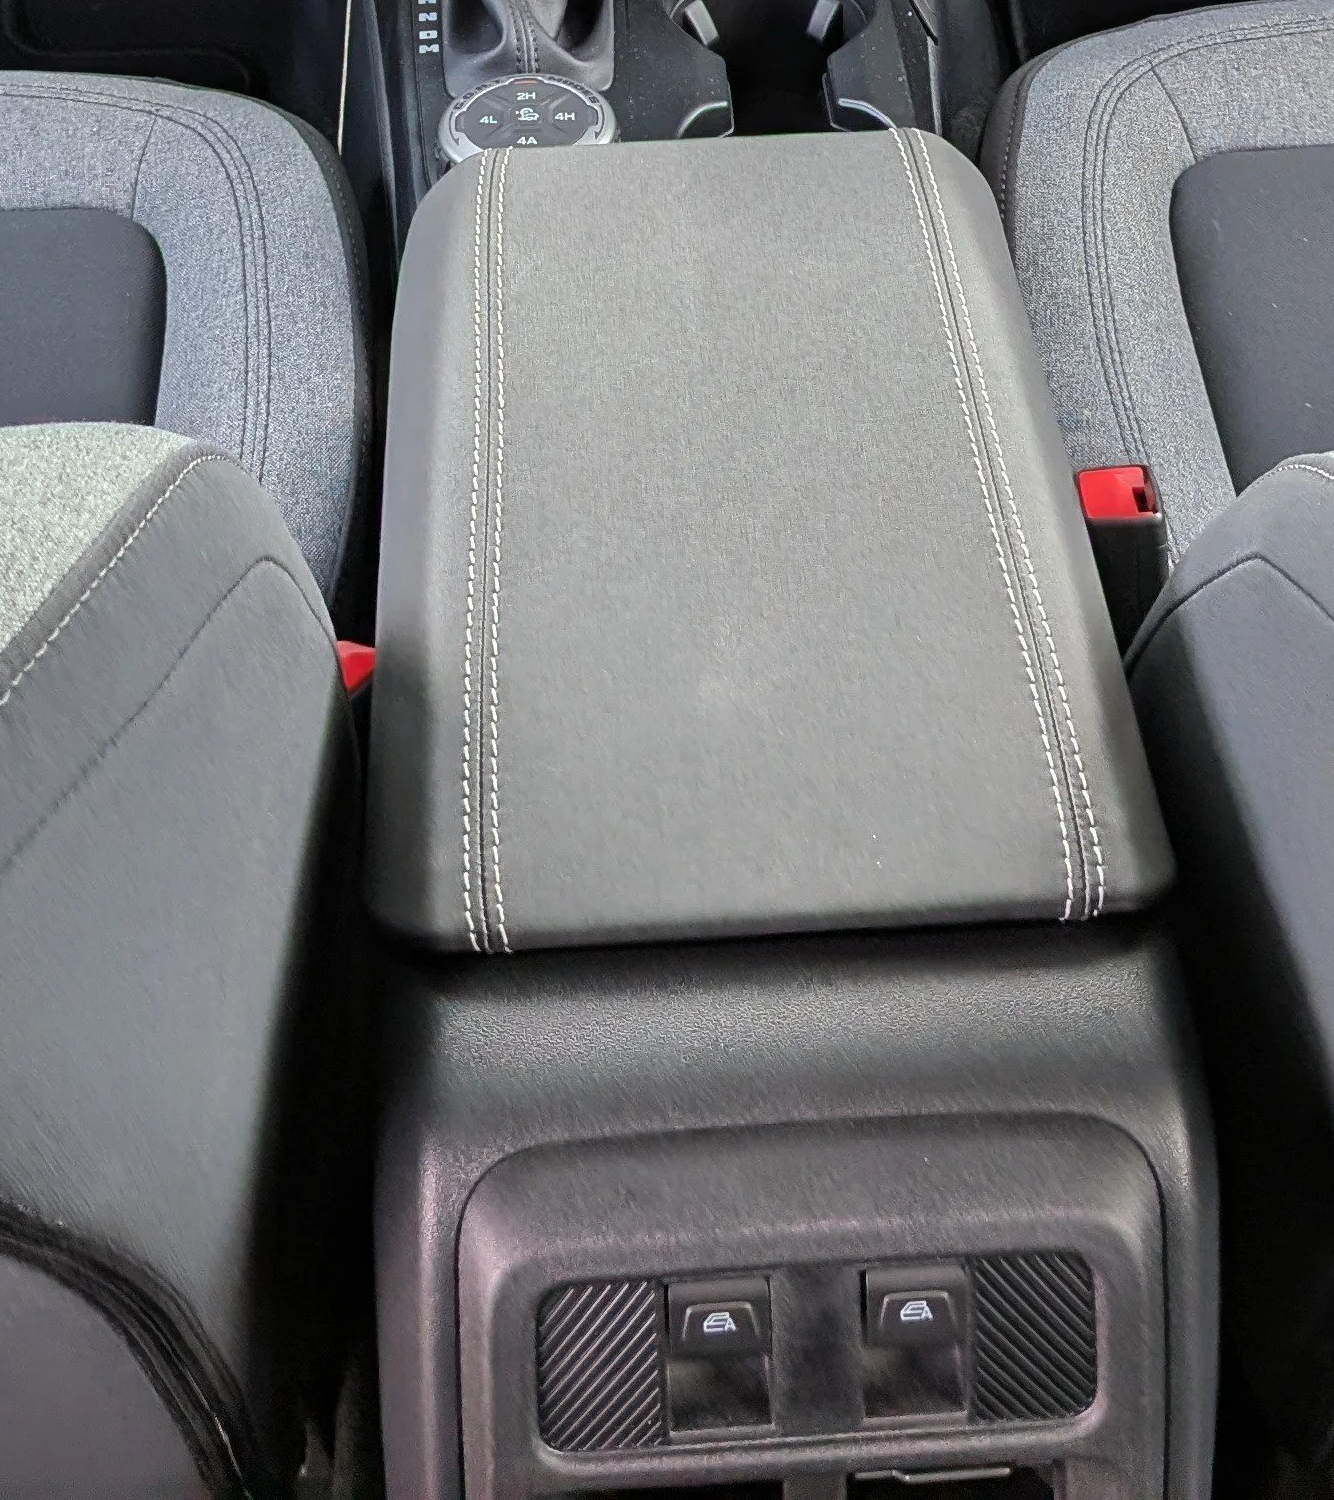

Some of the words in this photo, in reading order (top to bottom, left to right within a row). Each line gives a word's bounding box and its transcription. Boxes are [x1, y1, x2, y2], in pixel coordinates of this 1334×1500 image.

[418, 12, 437, 21] N
[419, 30, 438, 40] D
[419, 44, 440, 53] M
[517, 92, 536, 100] 2H
[479, 115, 498, 124] 4L
[554, 112, 575, 121] 4H
[517, 136, 538, 145] 4A
